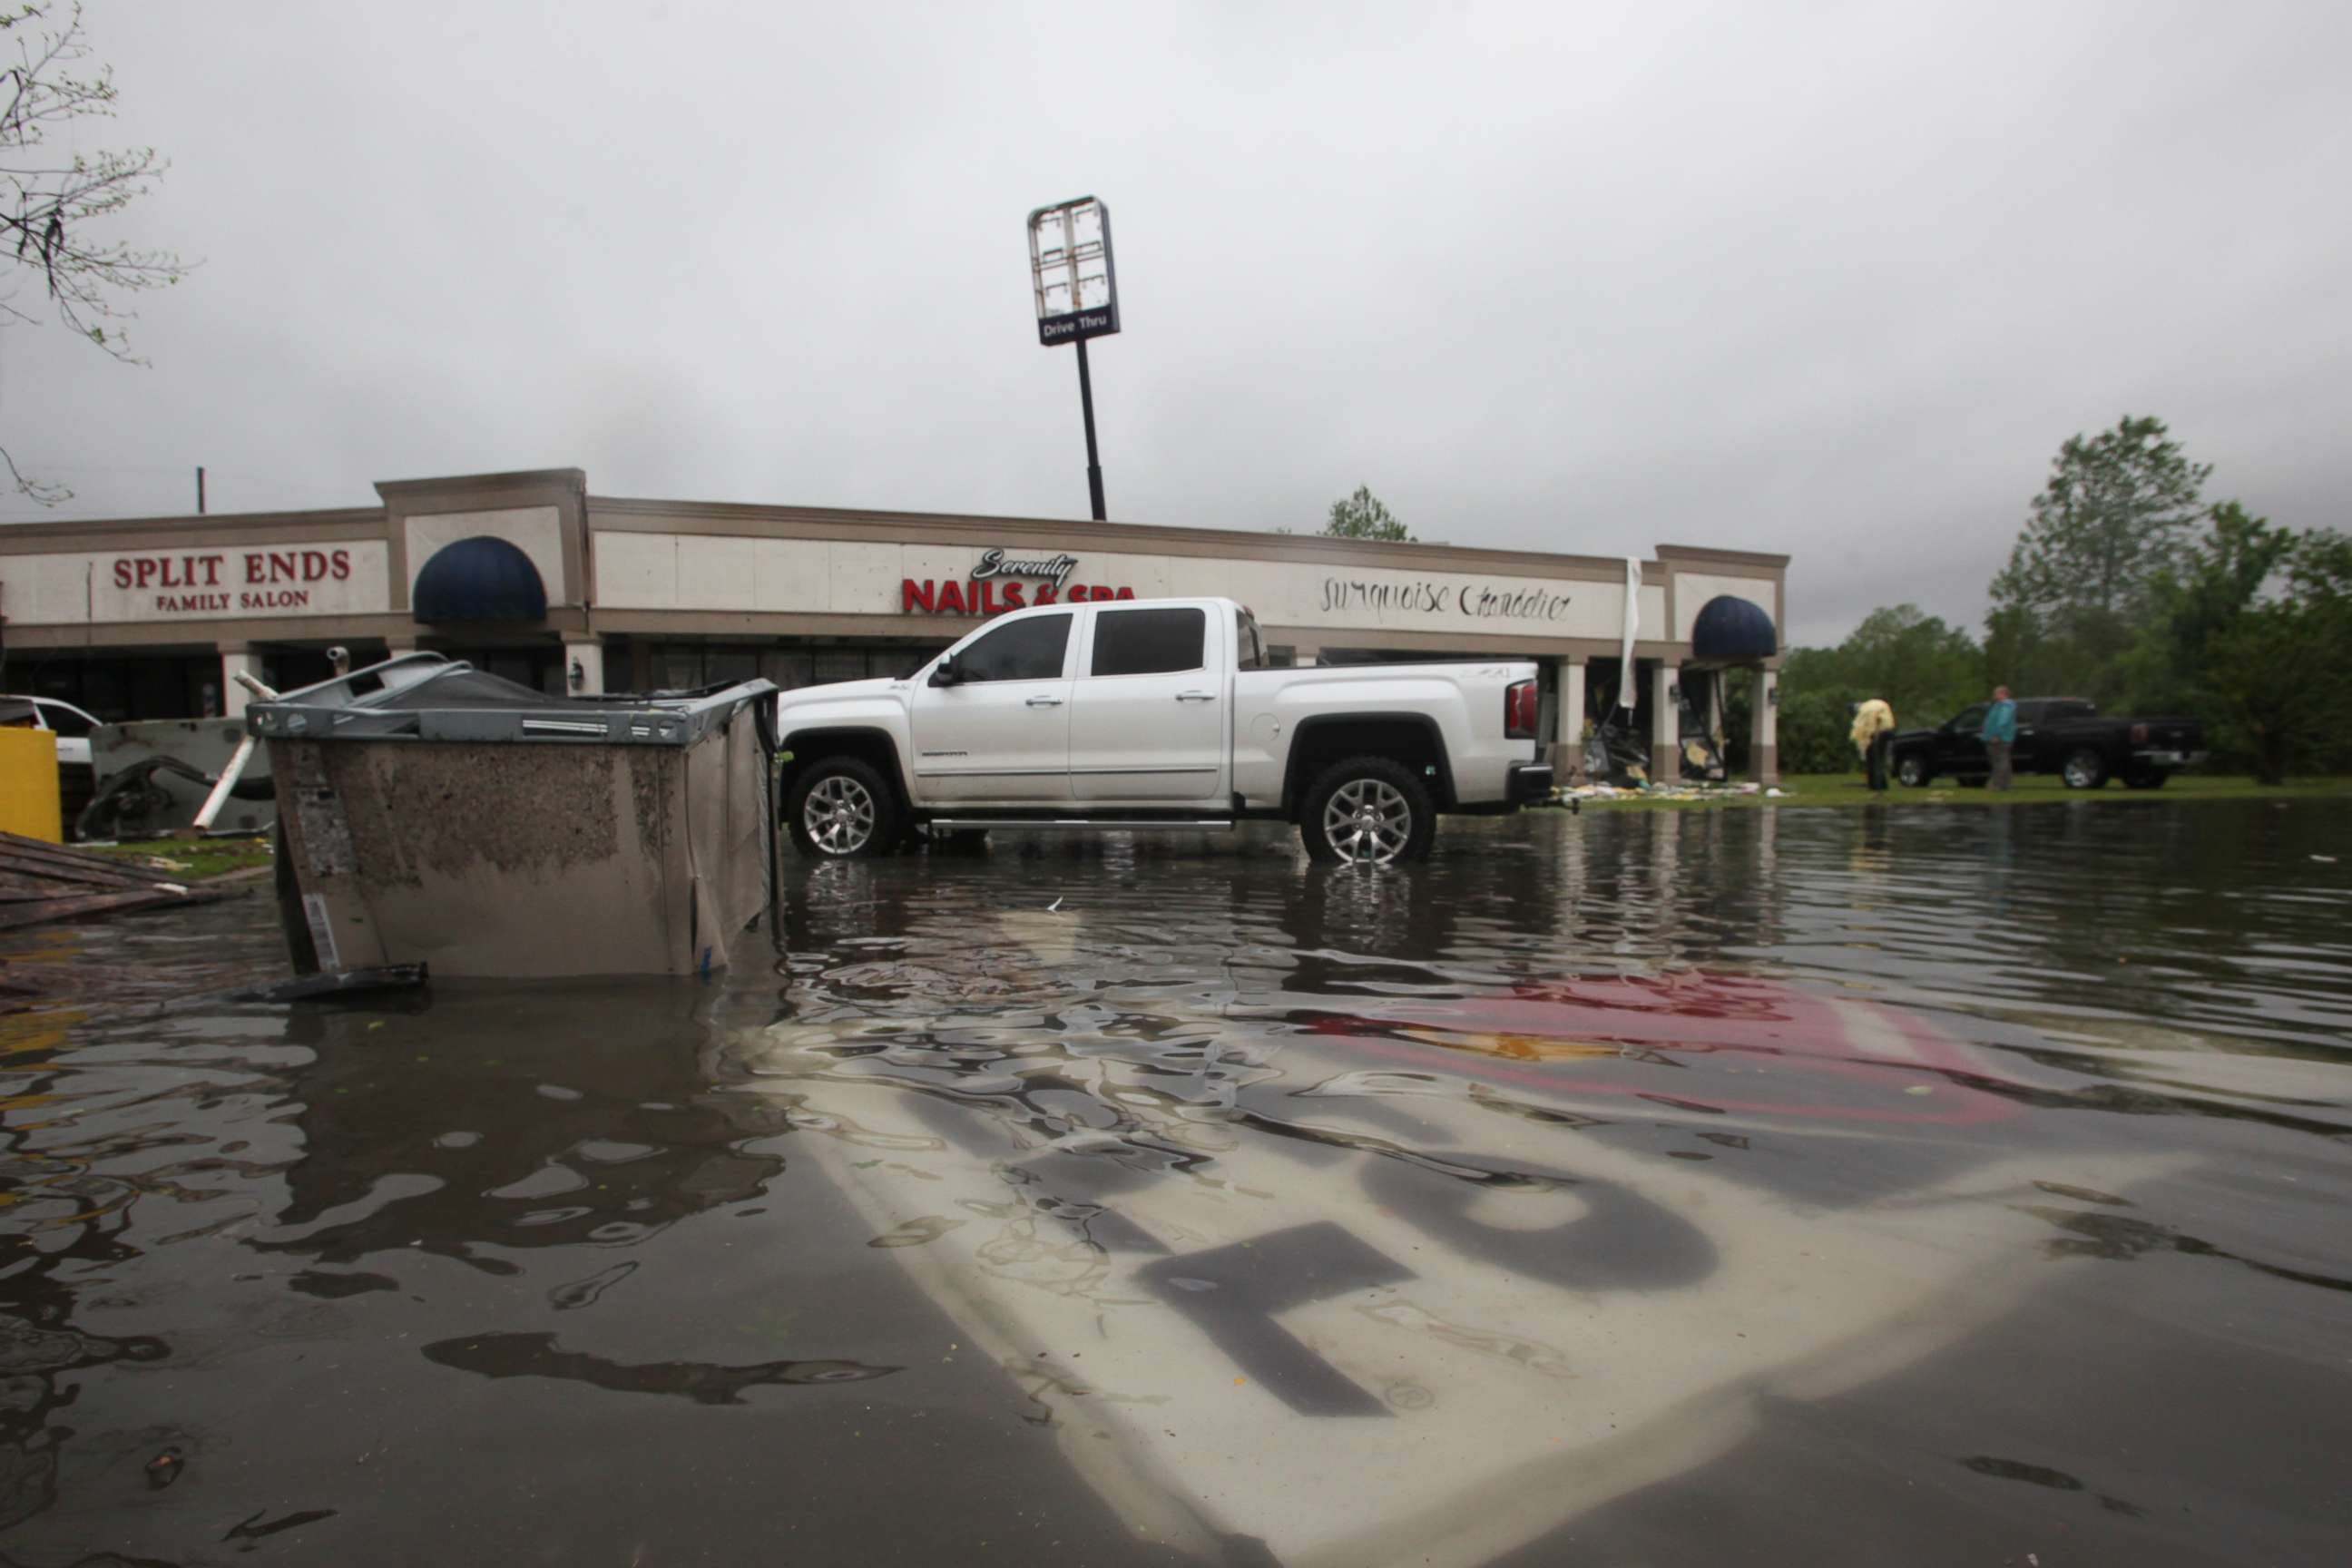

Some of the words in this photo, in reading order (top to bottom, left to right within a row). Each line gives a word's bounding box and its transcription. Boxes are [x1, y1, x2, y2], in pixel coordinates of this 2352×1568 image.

[1044, 321, 1075, 337] Drive
[1079, 315, 1107, 329] Thru
[113, 555, 224, 590] SPLIT
[243, 550, 350, 583] ENDS
[971, 547, 1078, 588] Serenity
[156, 593, 231, 612] FAMILY
[240, 591, 309, 610] SALON
[902, 579, 1026, 614] NAILS
[1033, 583, 1060, 606] &
